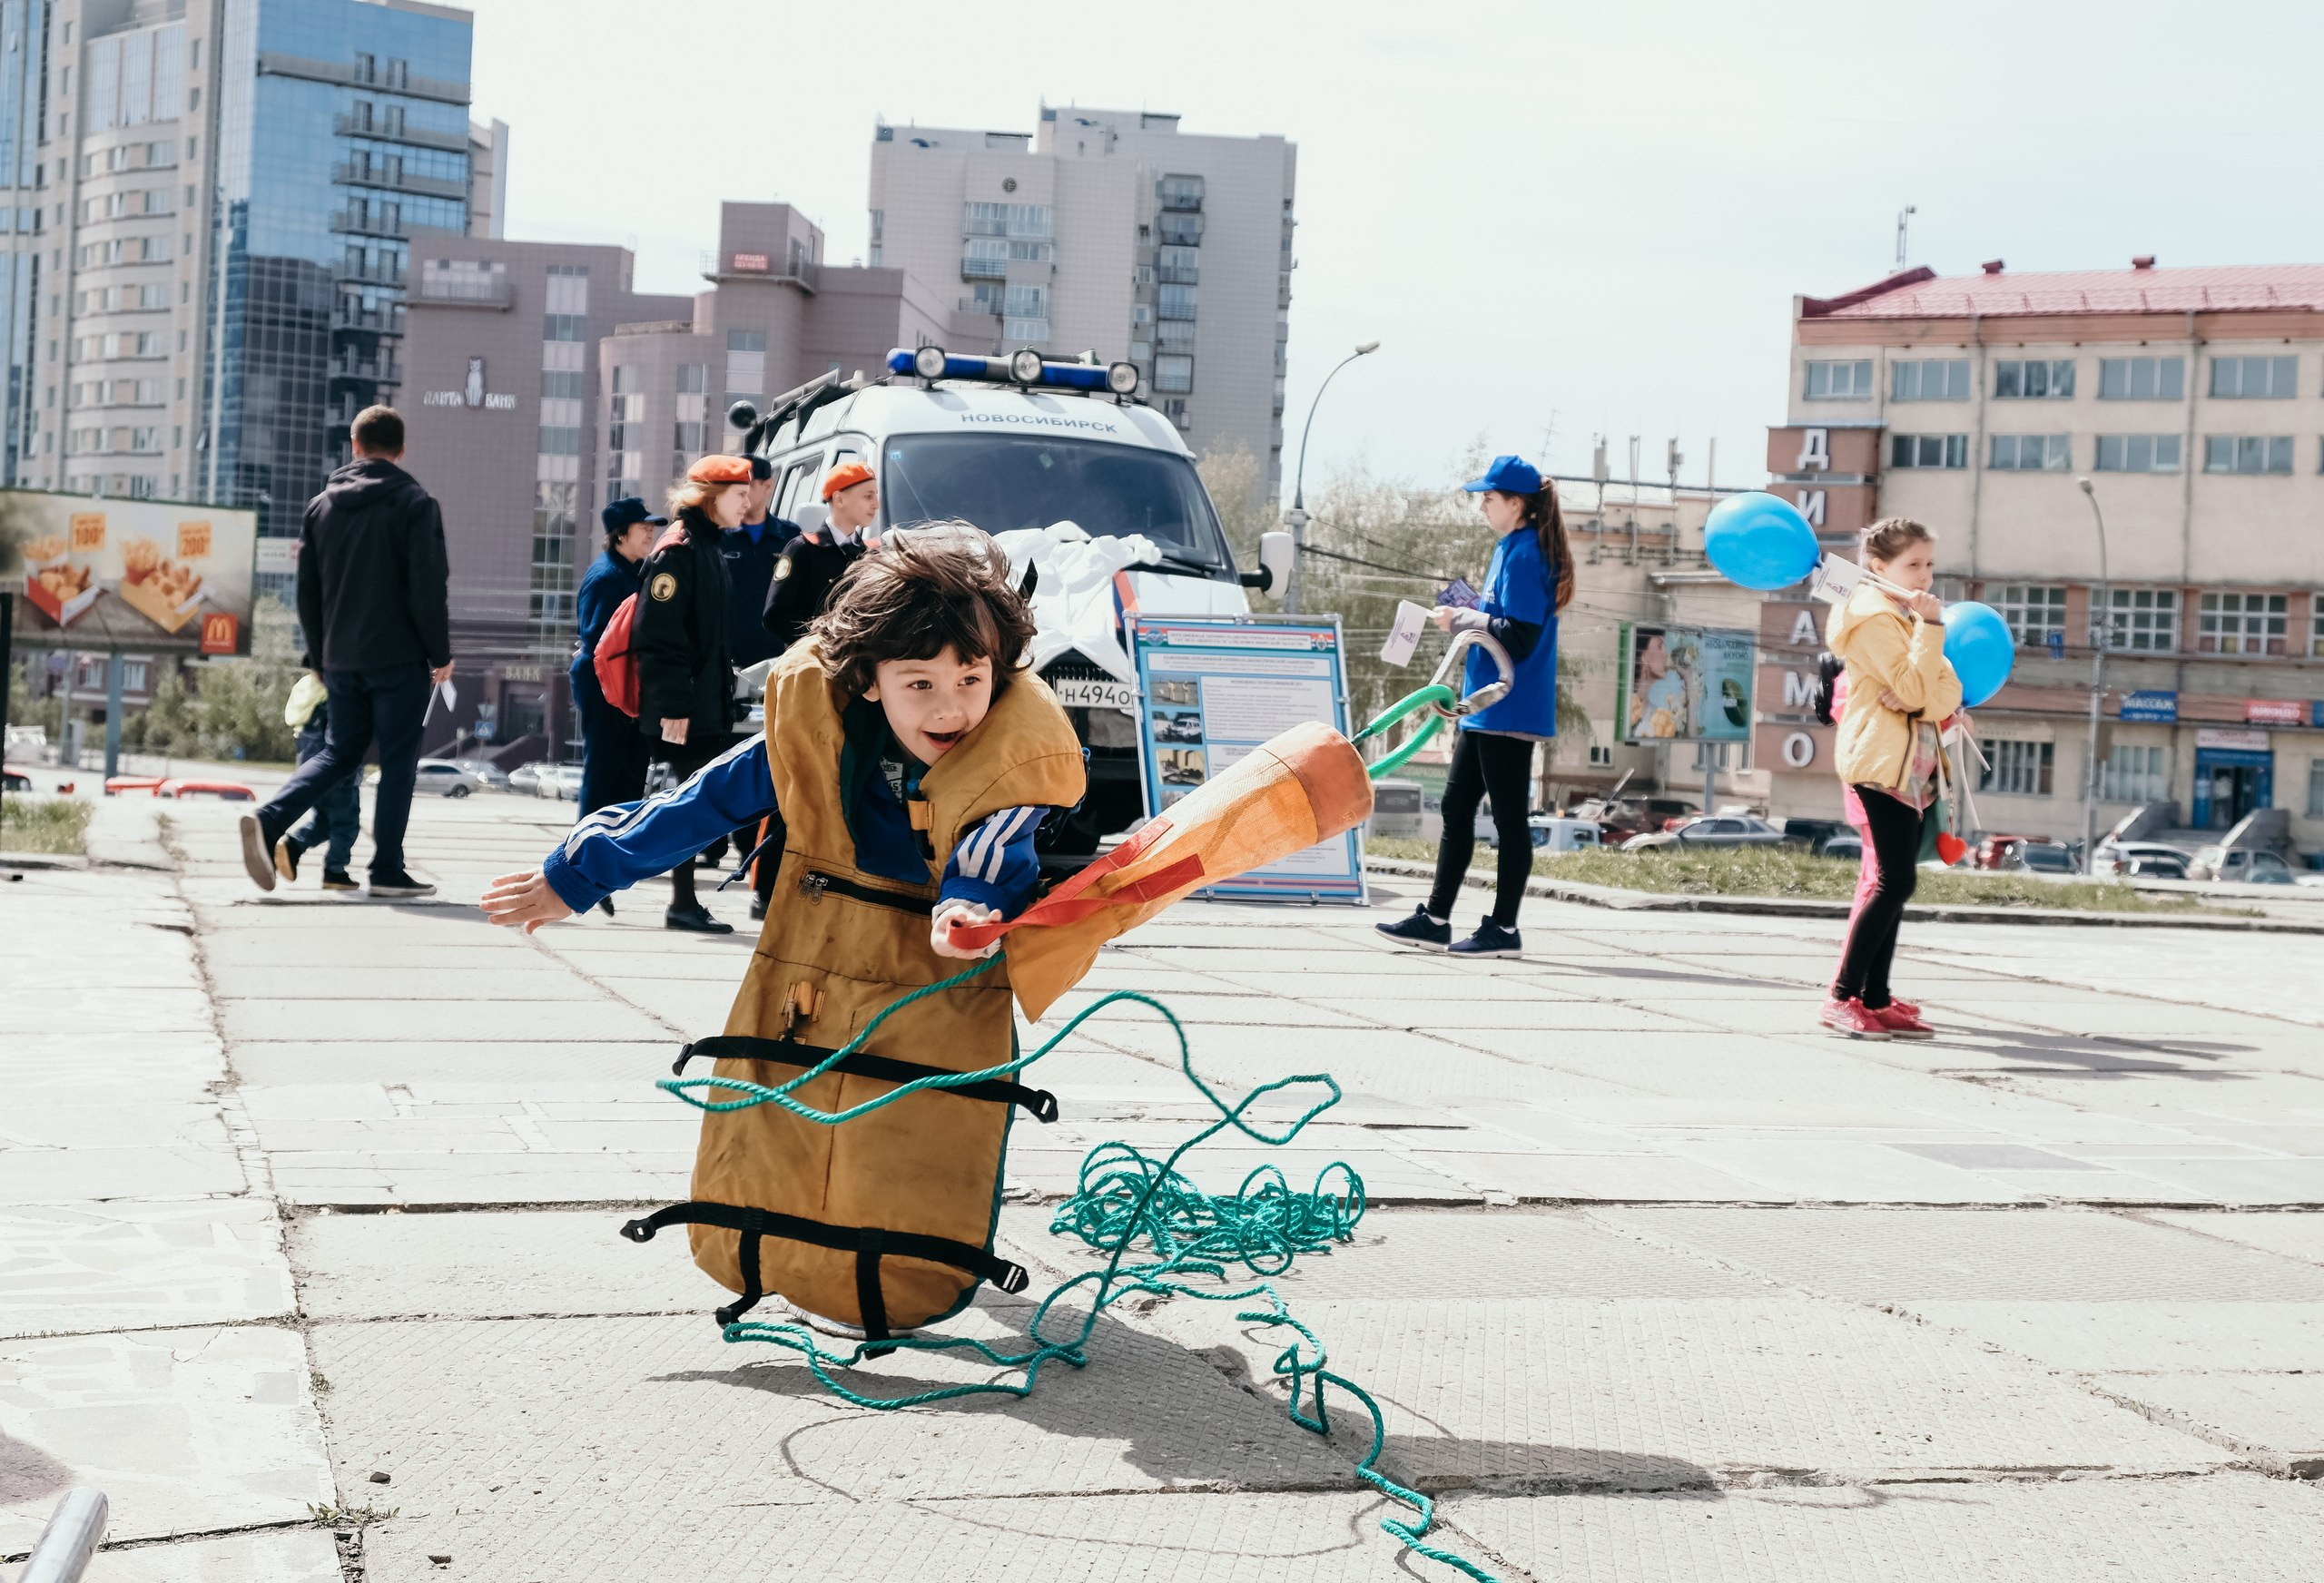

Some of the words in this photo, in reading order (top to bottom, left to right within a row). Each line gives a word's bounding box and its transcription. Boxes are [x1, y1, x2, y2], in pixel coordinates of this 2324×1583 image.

[485, 392, 517, 409] БАНК
[960, 413, 1118, 433] НОВОСИБИРСК
[1782, 428, 1829, 768] ДИАМО
[505, 665, 541, 681] БАНК
